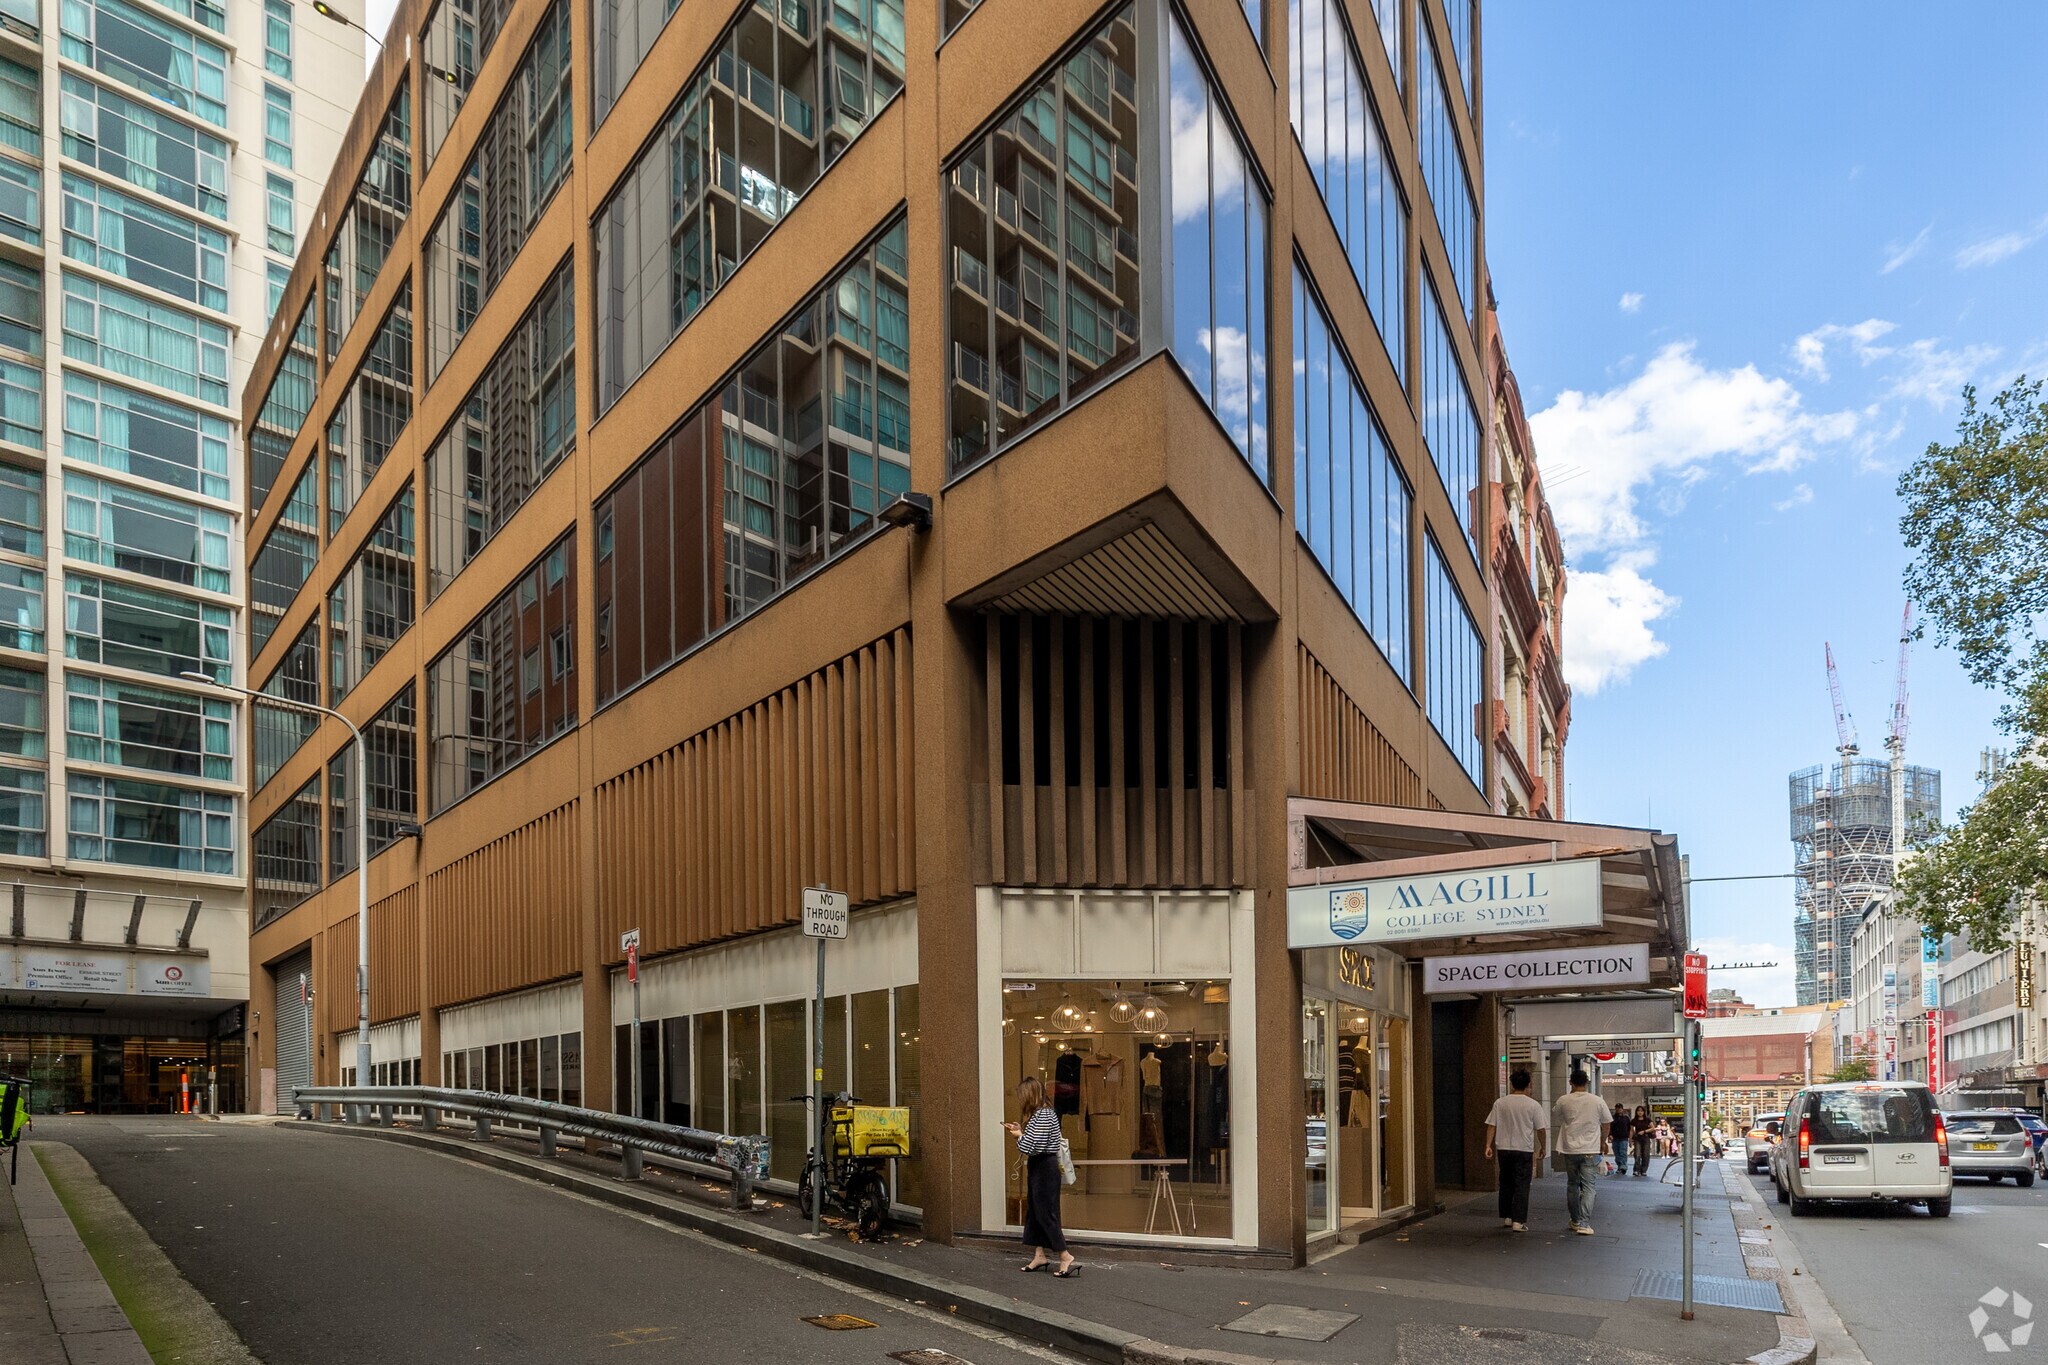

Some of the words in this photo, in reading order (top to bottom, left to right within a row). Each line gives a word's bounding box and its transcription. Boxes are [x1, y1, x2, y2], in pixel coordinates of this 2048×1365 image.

[1387, 872, 1549, 910] MAGILL
[820, 894, 834, 906] NO
[806, 907, 846, 922] THROUGH
[1386, 911, 1466, 928] COLLEGE
[1476, 903, 1549, 921] SYDNEY
[1496, 918, 1550, 927] www.magill.edu.au
[812, 923, 839, 936] ROAD
[1691, 958, 1700, 967] NO
[1438, 965, 1498, 982] SPACE
[1504, 957, 1634, 979] COLLECTION
[1685, 966, 1707, 975] STOPPING
